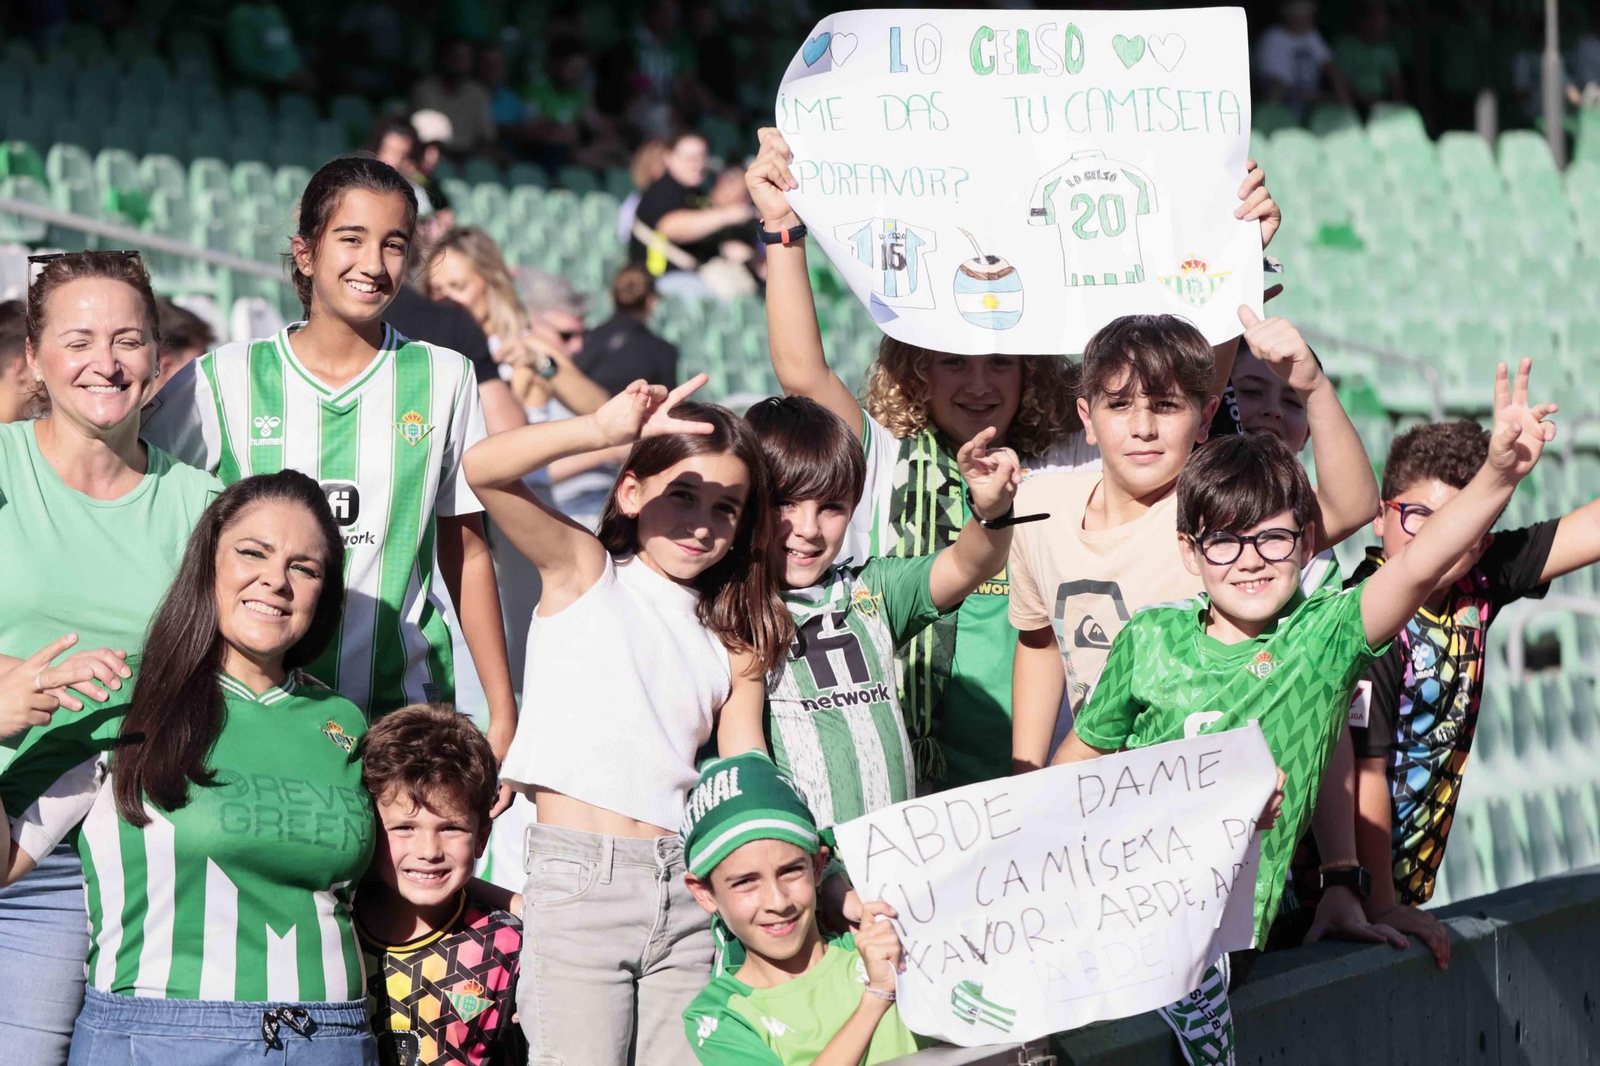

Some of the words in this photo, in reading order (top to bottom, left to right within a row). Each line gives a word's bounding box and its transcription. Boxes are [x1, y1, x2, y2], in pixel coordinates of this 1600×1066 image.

[889, 23, 943, 75] LO
[969, 22, 1085, 76] CELSO
[877, 90, 950, 132] DAS
[1003, 95, 1050, 134] TU
[1064, 86, 1242, 135] CAMISETA
[1065, 174, 1082, 188] LO
[1070, 193, 1127, 240] 20
[250, 436, 283, 446] hummel
[800, 683, 891, 712] network
[220, 802, 368, 856] GREEN
[865, 793, 1021, 883] ABDE
[1077, 748, 1223, 818] DAME
[1189, 988, 1221, 1031] BETIS
